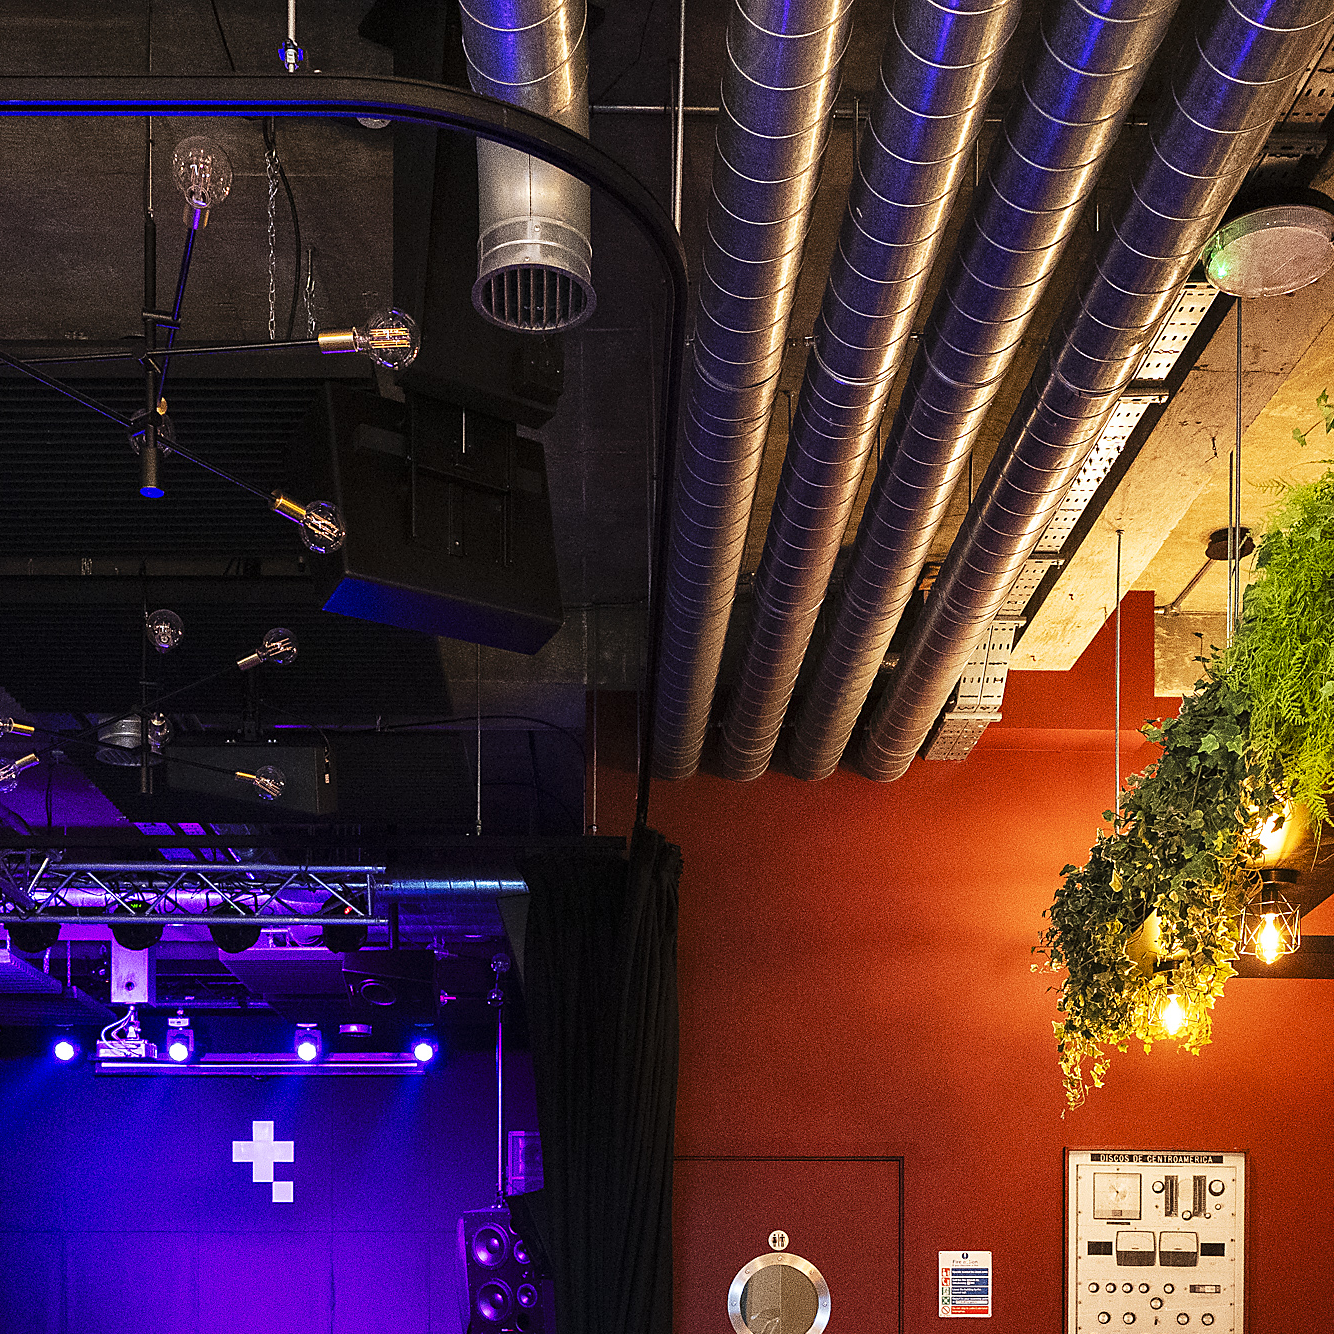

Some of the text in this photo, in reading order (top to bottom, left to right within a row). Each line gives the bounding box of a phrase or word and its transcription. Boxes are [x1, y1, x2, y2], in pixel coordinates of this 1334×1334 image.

[1100, 1154, 1214, 1164] DISCOS DE CENTROAMERICA
